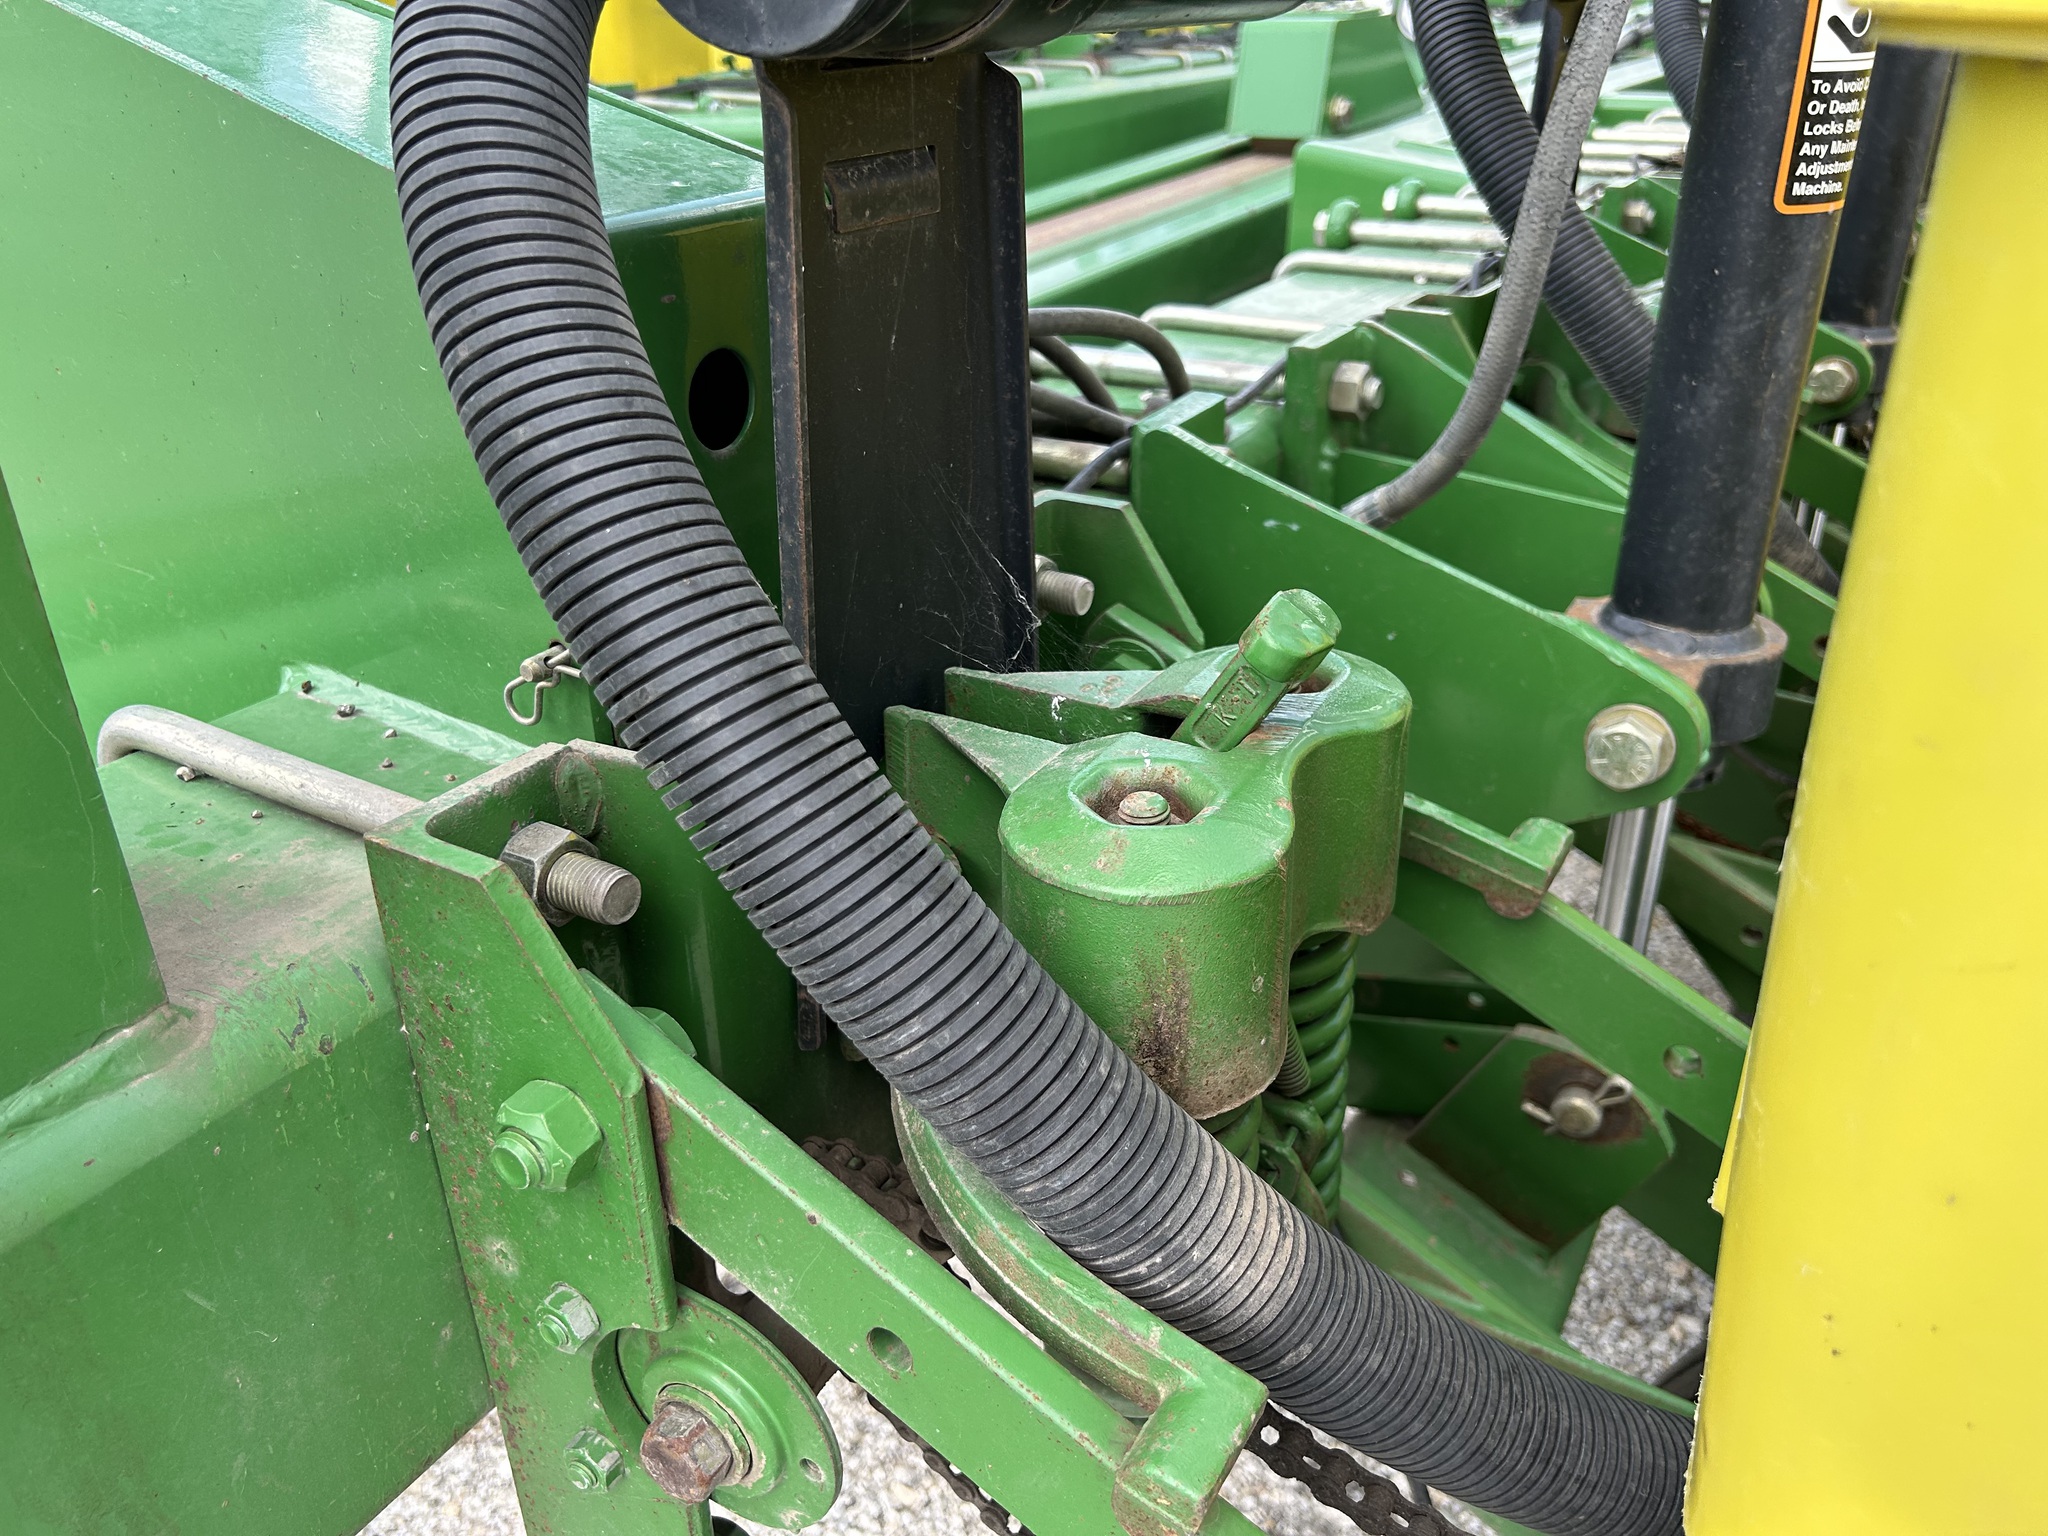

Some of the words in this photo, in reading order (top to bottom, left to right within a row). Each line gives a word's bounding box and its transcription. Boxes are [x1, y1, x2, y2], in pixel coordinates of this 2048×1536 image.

[1811, 80, 1831, 94] To
[1833, 77, 1864, 94] Avoid
[1807, 100, 1827, 115] Or
[1803, 120, 1844, 136] Locks
[1799, 142, 1828, 158] Any
[1792, 180, 1843, 195] Machine.
